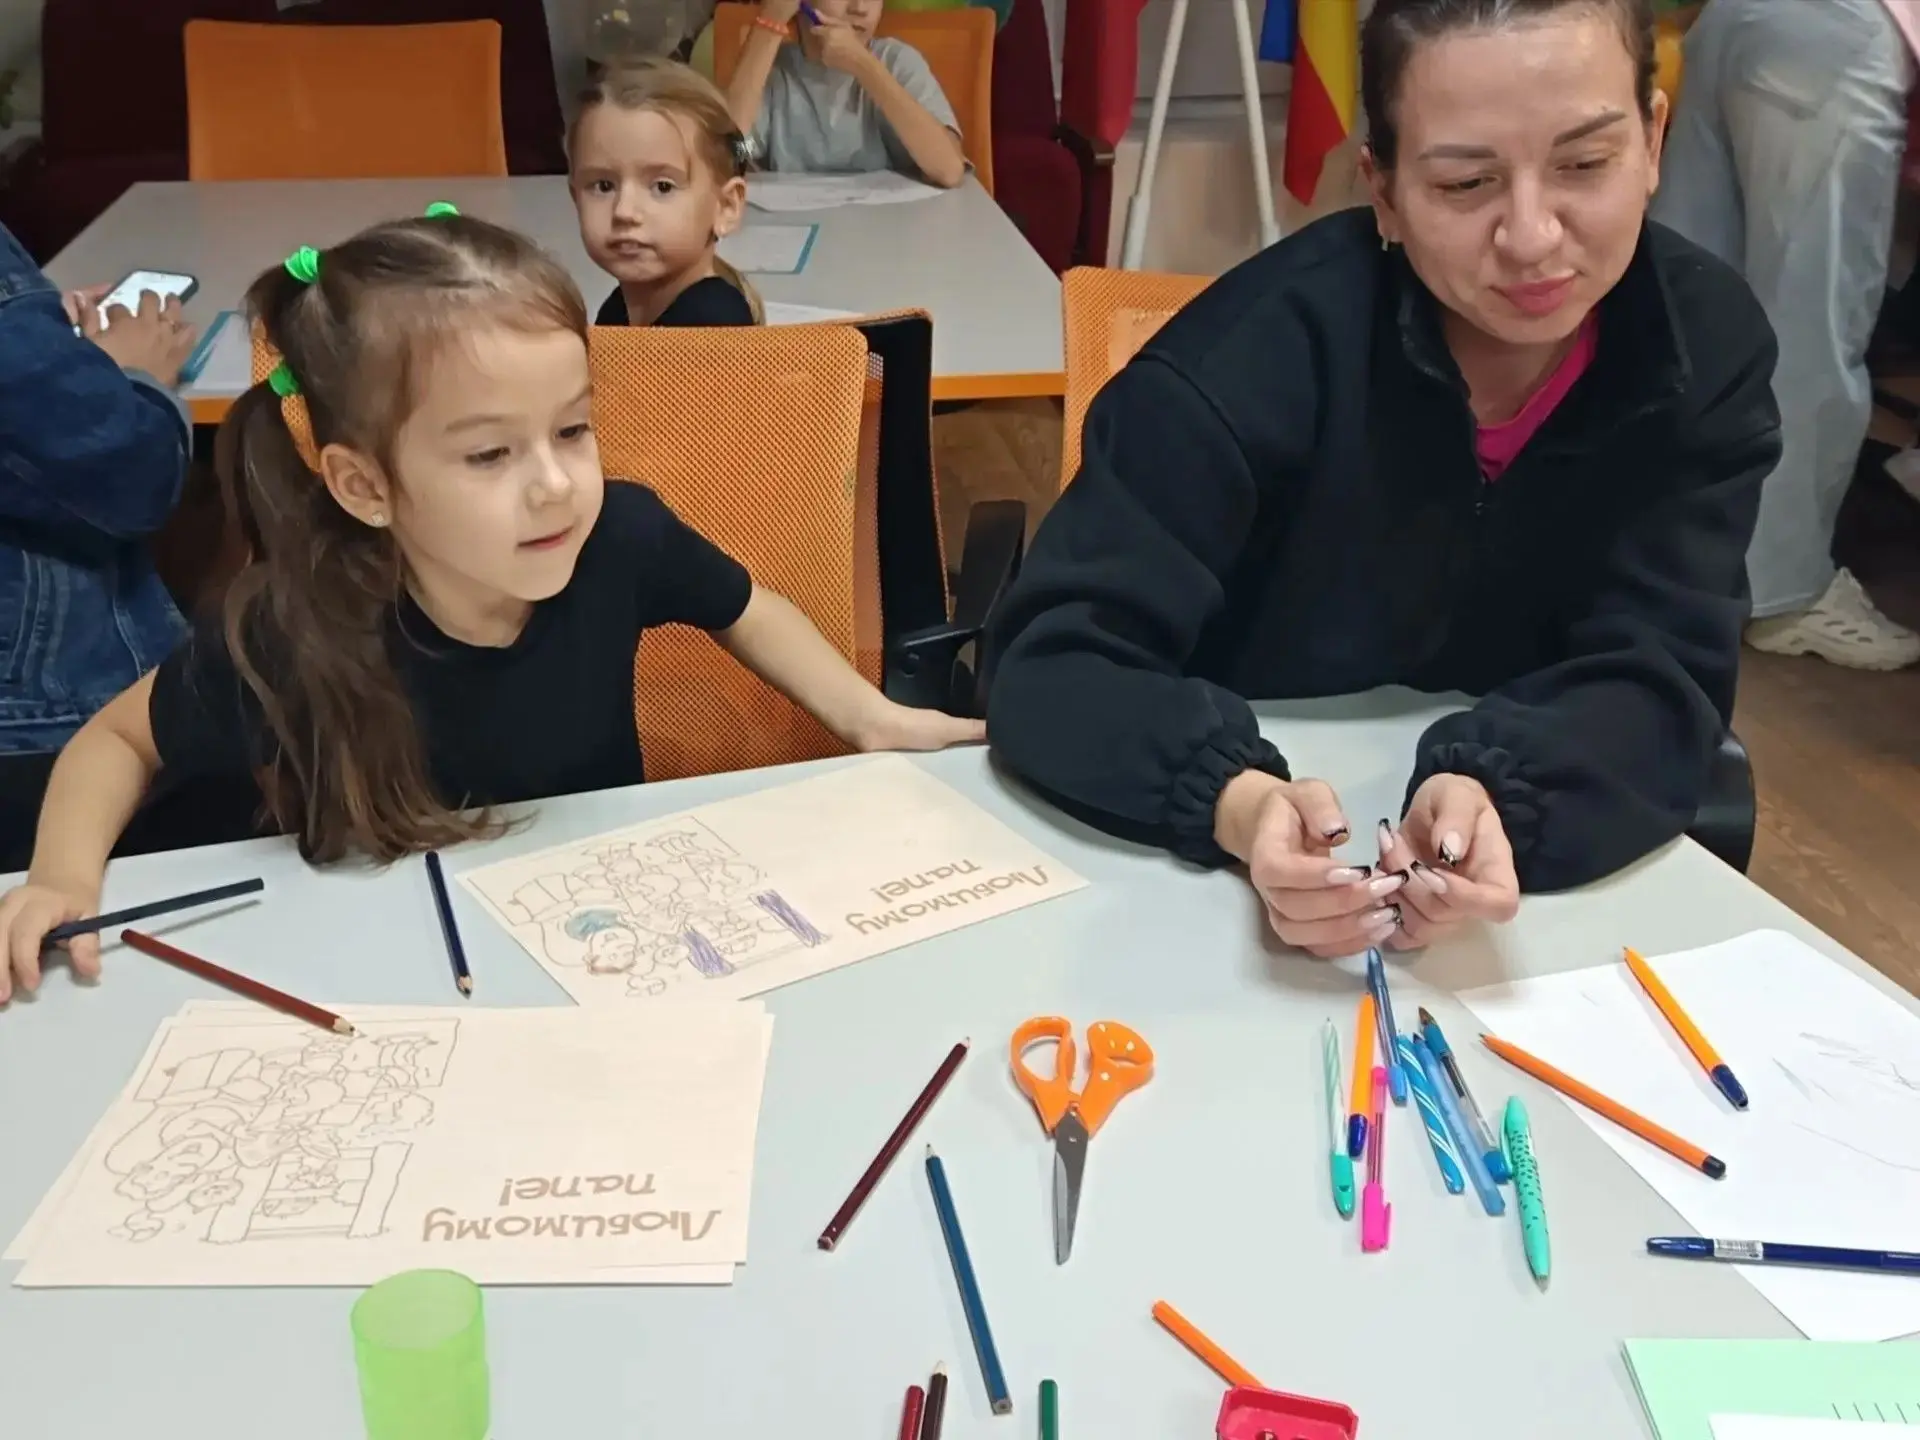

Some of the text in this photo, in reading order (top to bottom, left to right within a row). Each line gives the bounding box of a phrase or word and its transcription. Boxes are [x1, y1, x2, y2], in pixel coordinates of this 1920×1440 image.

[845, 864, 1050, 935] Любимому
[869, 858, 983, 904] папе!
[498, 1173, 656, 1206] папе!
[422, 1207, 722, 1242] Любимому
